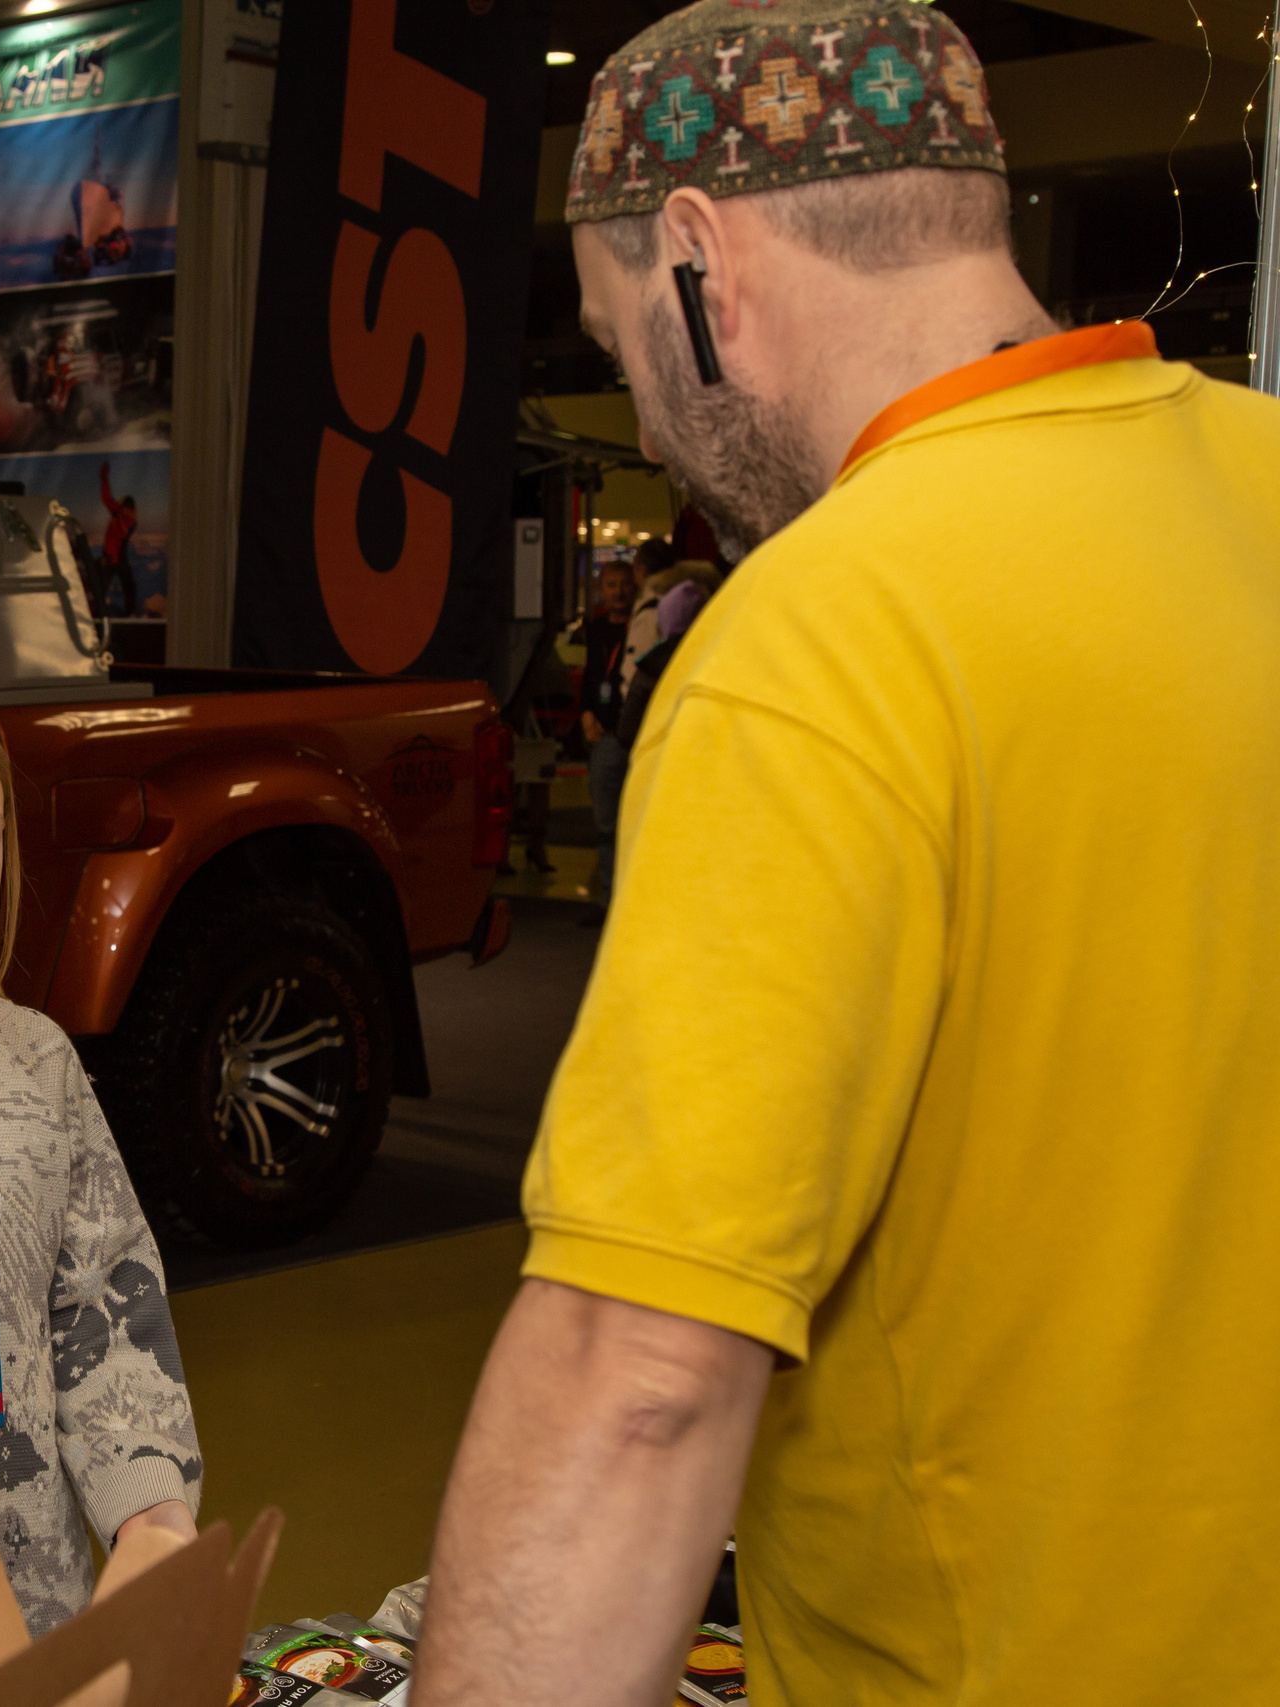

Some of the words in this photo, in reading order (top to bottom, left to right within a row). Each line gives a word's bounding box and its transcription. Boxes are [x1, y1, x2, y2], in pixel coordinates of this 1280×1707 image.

[314, 0, 486, 674] CST
[381, 1671, 407, 1685] УХА
[289, 1683, 312, 1700] ТОМ
